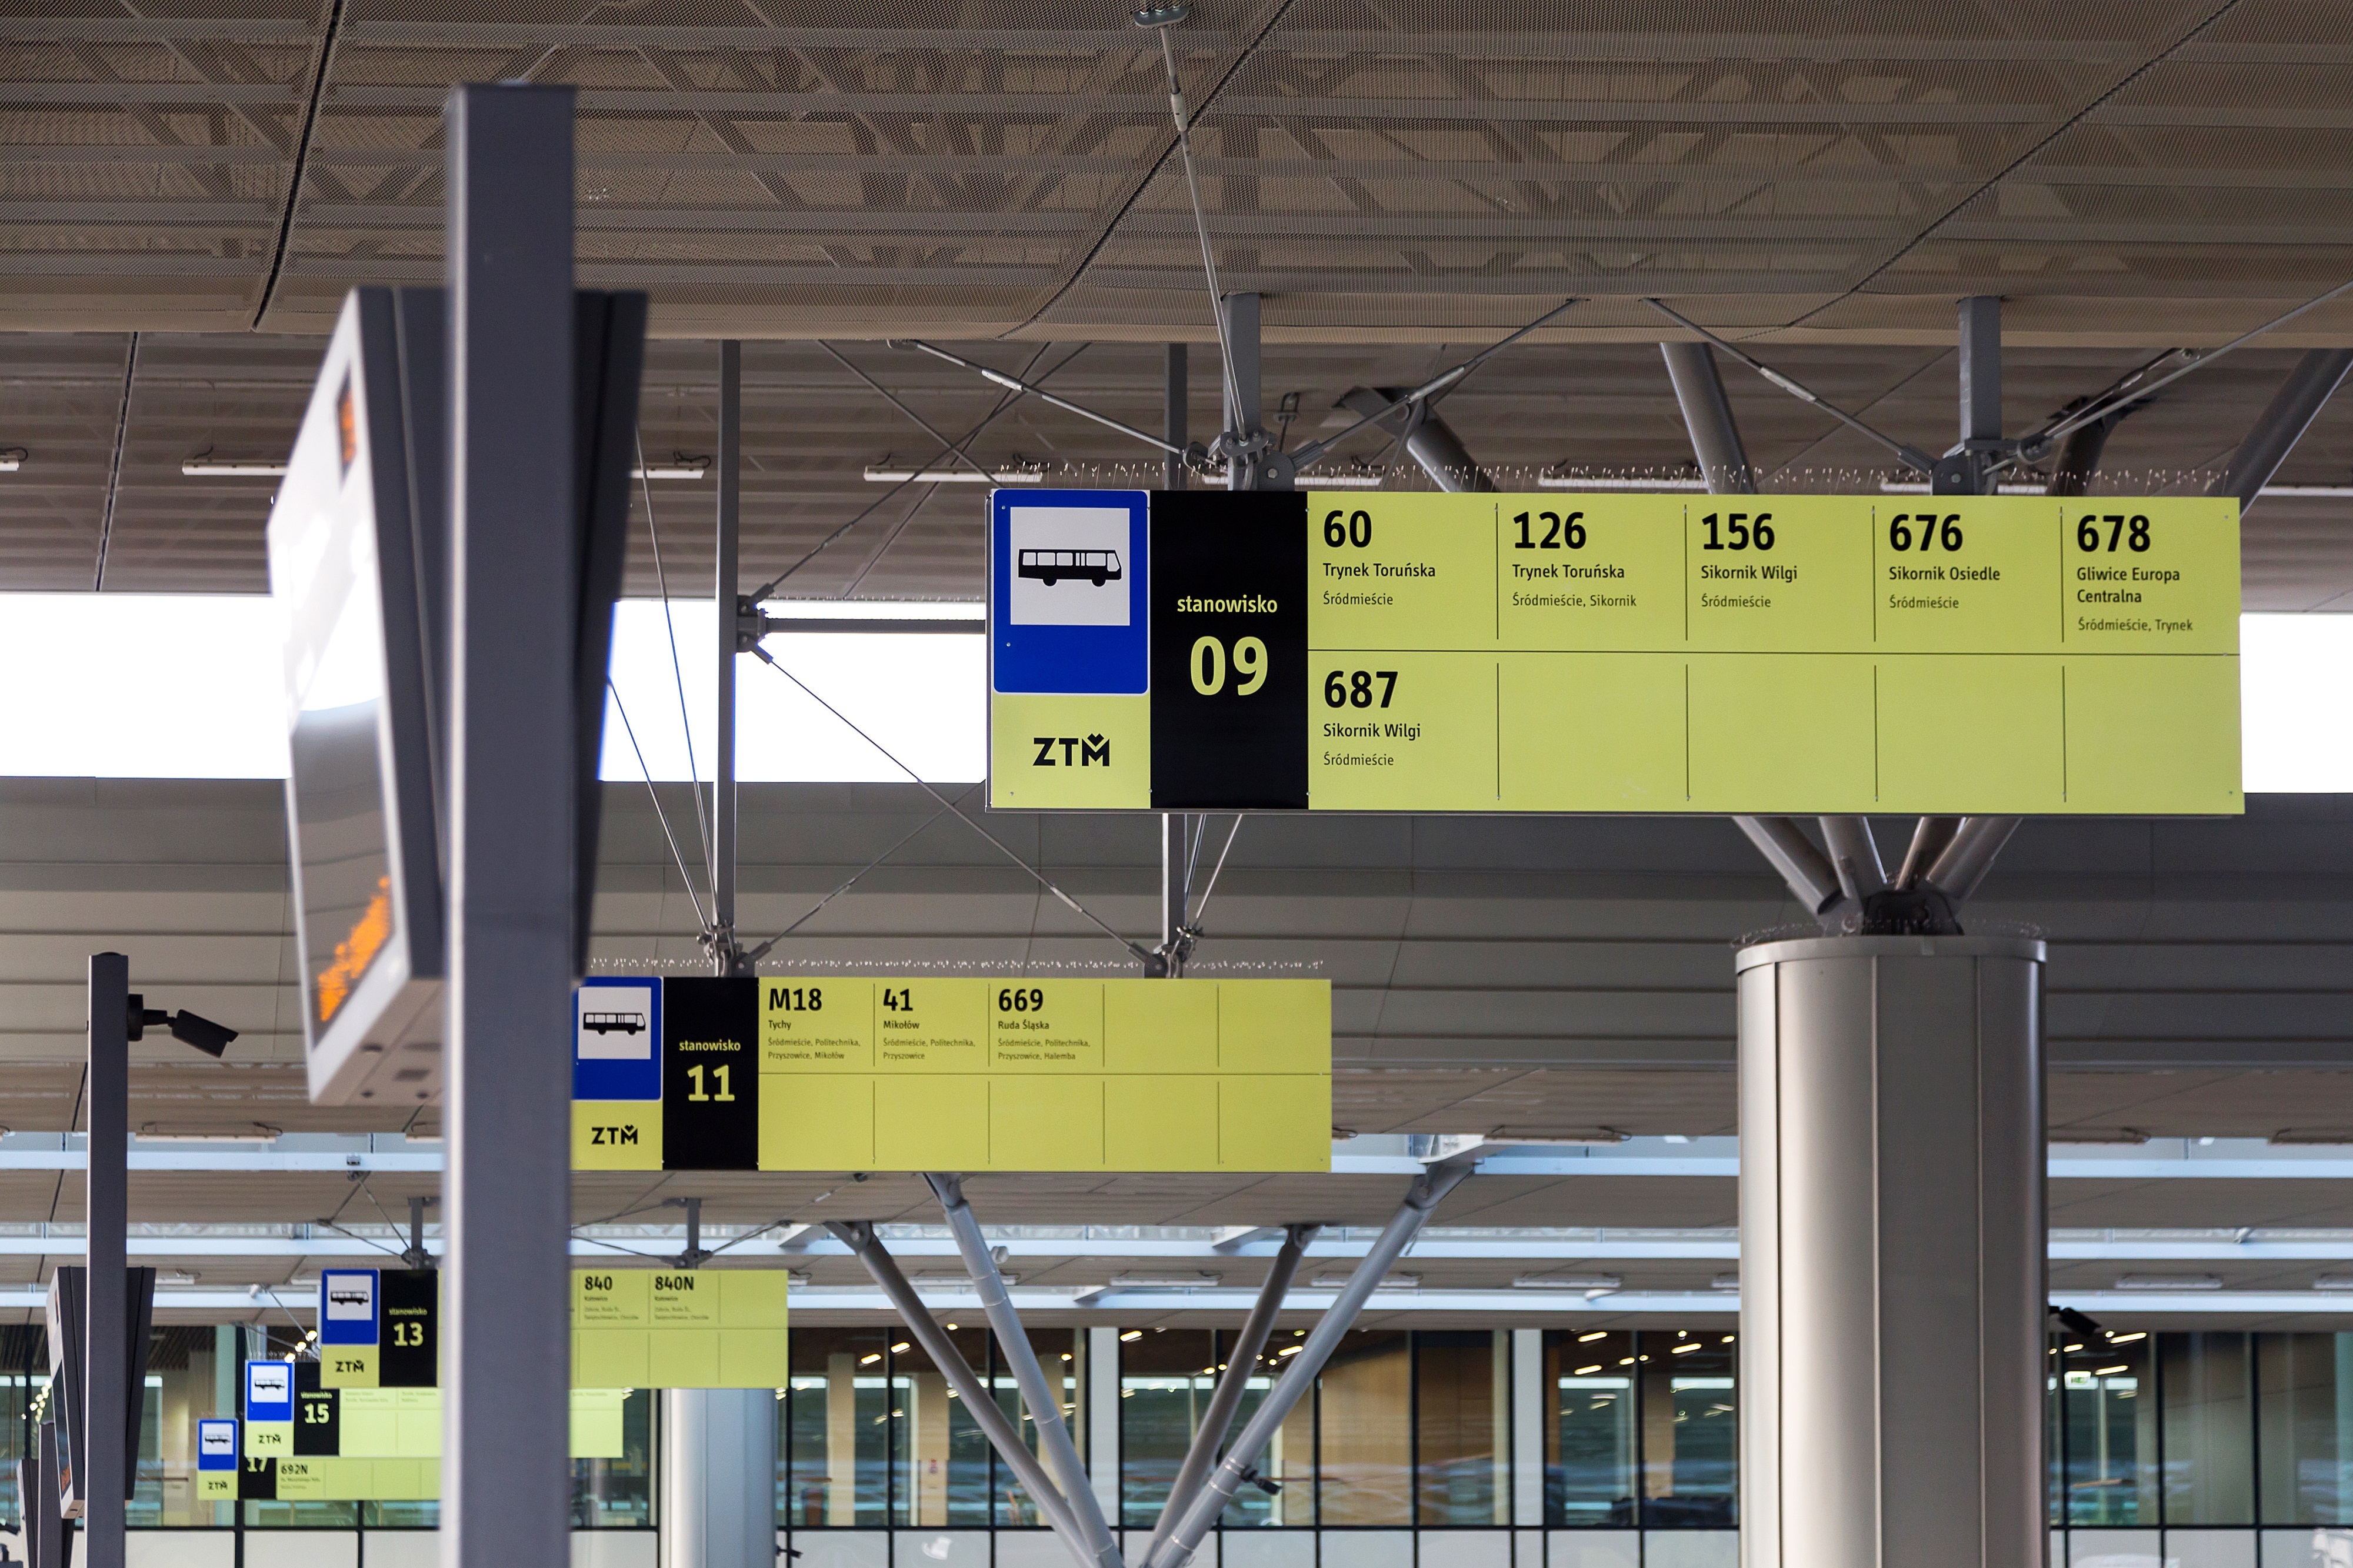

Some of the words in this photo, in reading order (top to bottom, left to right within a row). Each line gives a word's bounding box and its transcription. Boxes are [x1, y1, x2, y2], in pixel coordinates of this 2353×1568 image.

[1324, 509, 1372, 548] 60
[1513, 511, 1587, 549] 126
[1702, 512, 1775, 551] 156
[1889, 513, 1963, 552] 676
[2077, 514, 2151, 553] 678
[1323, 562, 1369, 580] Trynek
[1373, 562, 1435, 577] Toruńska
[1512, 563, 1558, 581] Trynek
[1562, 563, 1625, 578] Toruńska
[1701, 565, 1757, 579] Sikornik
[1762, 565, 1797, 583] Wilgi
[1889, 566, 1945, 581] Sikornik
[1949, 566, 2001, 581] Osiedle
[2077, 566, 2127, 581] Gliwice
[2132, 567, 2180, 585] Europa
[1176, 594, 1278, 613] stanowisko
[1323, 590, 1394, 605] Śródmieście
[1512, 591, 1586, 608] Śródmieście,
[1590, 592, 1637, 606] Sikornik
[1701, 592, 1771, 608] Śródmieście
[1889, 594, 1959, 609] Śródmieście
[2077, 589, 2142, 603] Centralna
[2078, 616, 2151, 632] Śródmieście,
[2155, 619, 2193, 634] Trynek
[1190, 635, 1268, 696] 09
[1324, 670, 1398, 709] 687
[1323, 722, 1380, 738] Sikornik
[1385, 723, 1421, 741] Wilgi
[1032, 733, 1110, 767] ZTM
[1324, 750, 1394, 766] Śródmieście
[769, 987, 822, 1012] M18
[883, 988, 914, 1012] 41
[998, 988, 1044, 1012] 669
[768, 1019, 792, 1031] Tychy
[883, 1020, 920, 1029] Mikołów
[998, 1020, 1020, 1029] Ruda
[1022, 1019, 1049, 1032] Śląska
[679, 1039, 741, 1052] stanowisko
[768, 1037, 813, 1047] Śródmieście,
[815, 1038, 861, 1047] Politechnika,
[883, 1037, 928, 1047] Śródmieście,
[931, 1038, 976, 1047] Politechnika,
[998, 1037, 1043, 1047] Śródmieście,
[1045, 1039, 1091, 1047] Politechnika,
[768, 1052, 812, 1060] Przyszowice,
[815, 1052, 845, 1060] Mikołów
[883, 1052, 925, 1061] Przyszowice
[998, 1052, 1042, 1061] Przyszowice,
[687, 1064, 735, 1102] 11
[591, 1124, 638, 1145] ZTM
[584, 1276, 613, 1291] 840
[655, 1276, 694, 1291] 840N
[394, 1322, 424, 1346] 13
[335, 1360, 364, 1373] ZTM
[304, 1403, 329, 1424] 15
[259, 1434, 281, 1444] ZTM
[281, 1464, 308, 1474] 692N
[208, 1481, 228, 1490] ZTM
